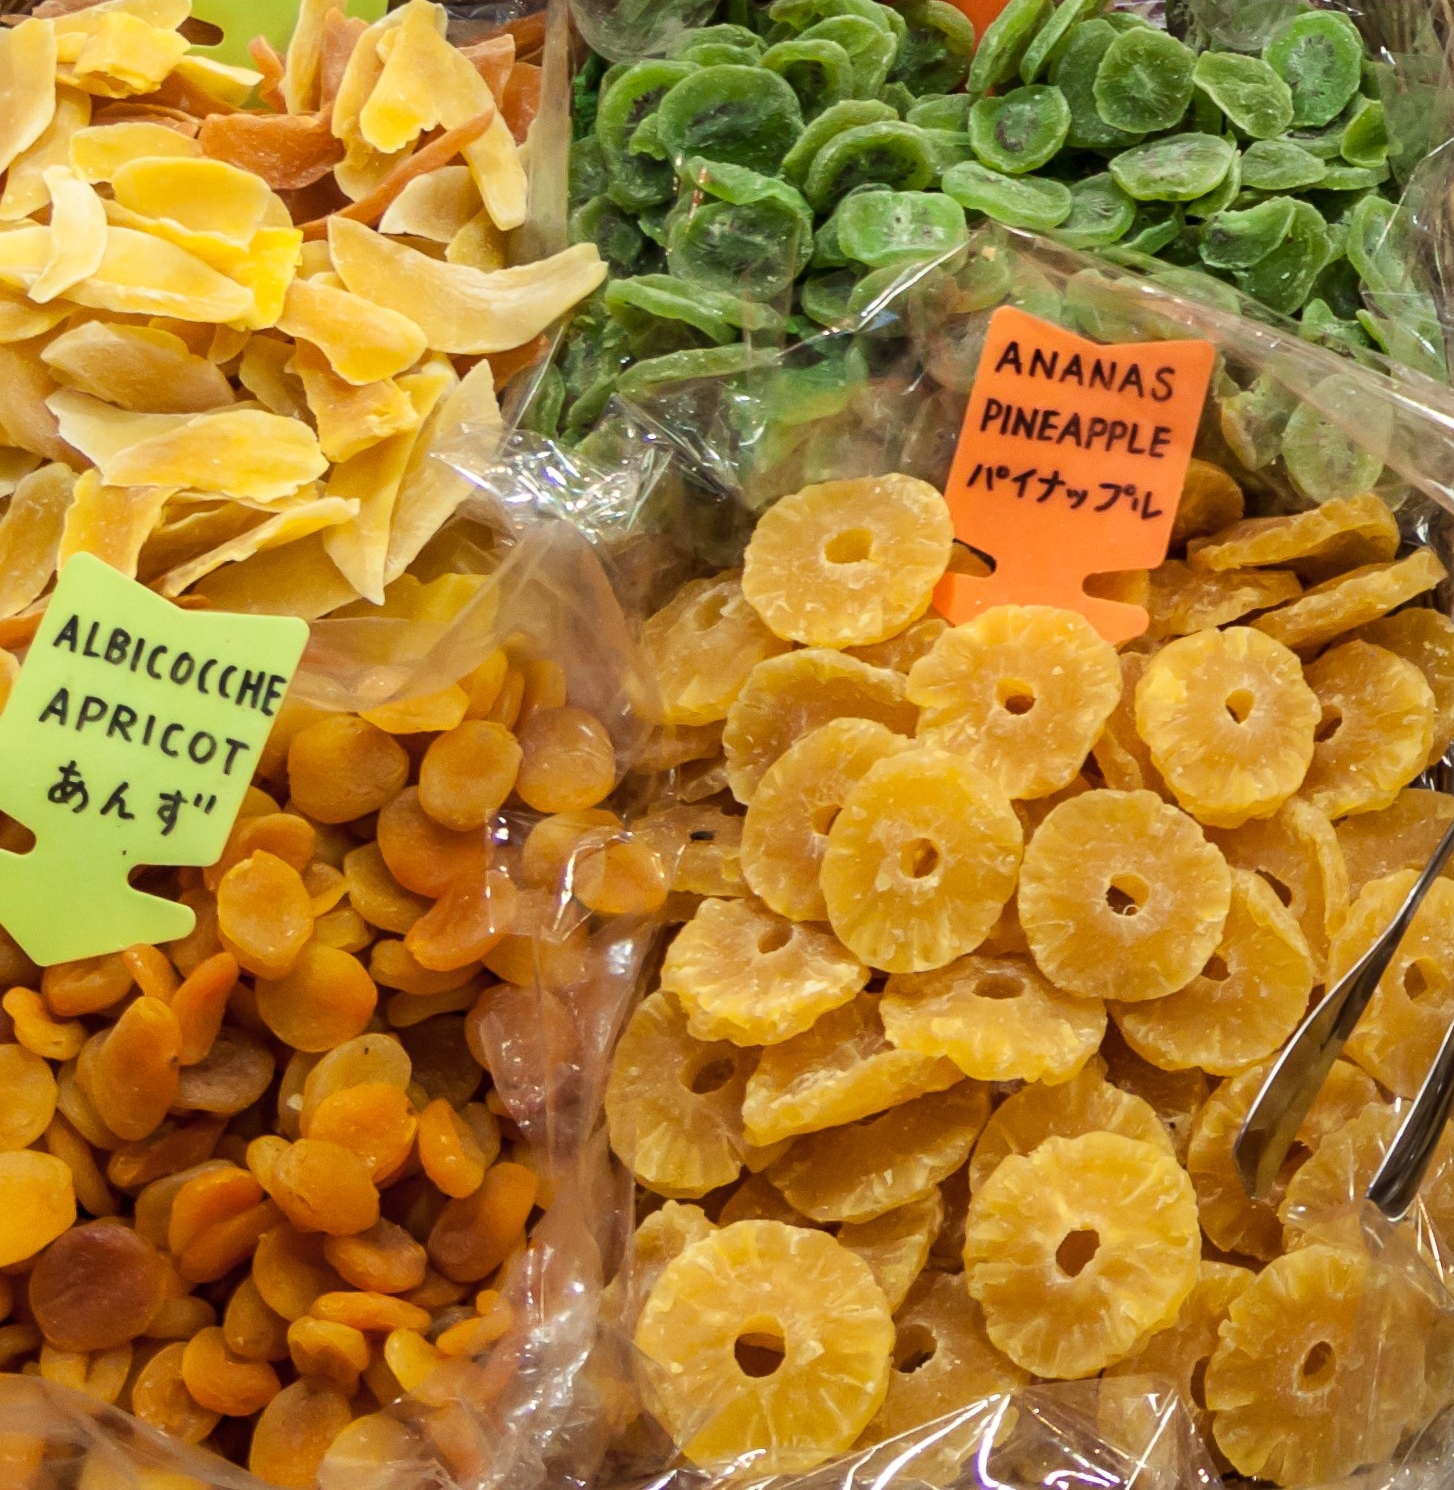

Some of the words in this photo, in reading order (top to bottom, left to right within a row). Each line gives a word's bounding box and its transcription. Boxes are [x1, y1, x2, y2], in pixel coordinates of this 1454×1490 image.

[995, 341, 1176, 403] ANANAS
[979, 397, 1172, 458] PINEAPPLE
[966, 463, 1163, 521] パイナップル
[53, 614, 288, 717] ALBICOCCHE
[38, 687, 250, 776] APRICOT
[47, 760, 218, 837] あんず
